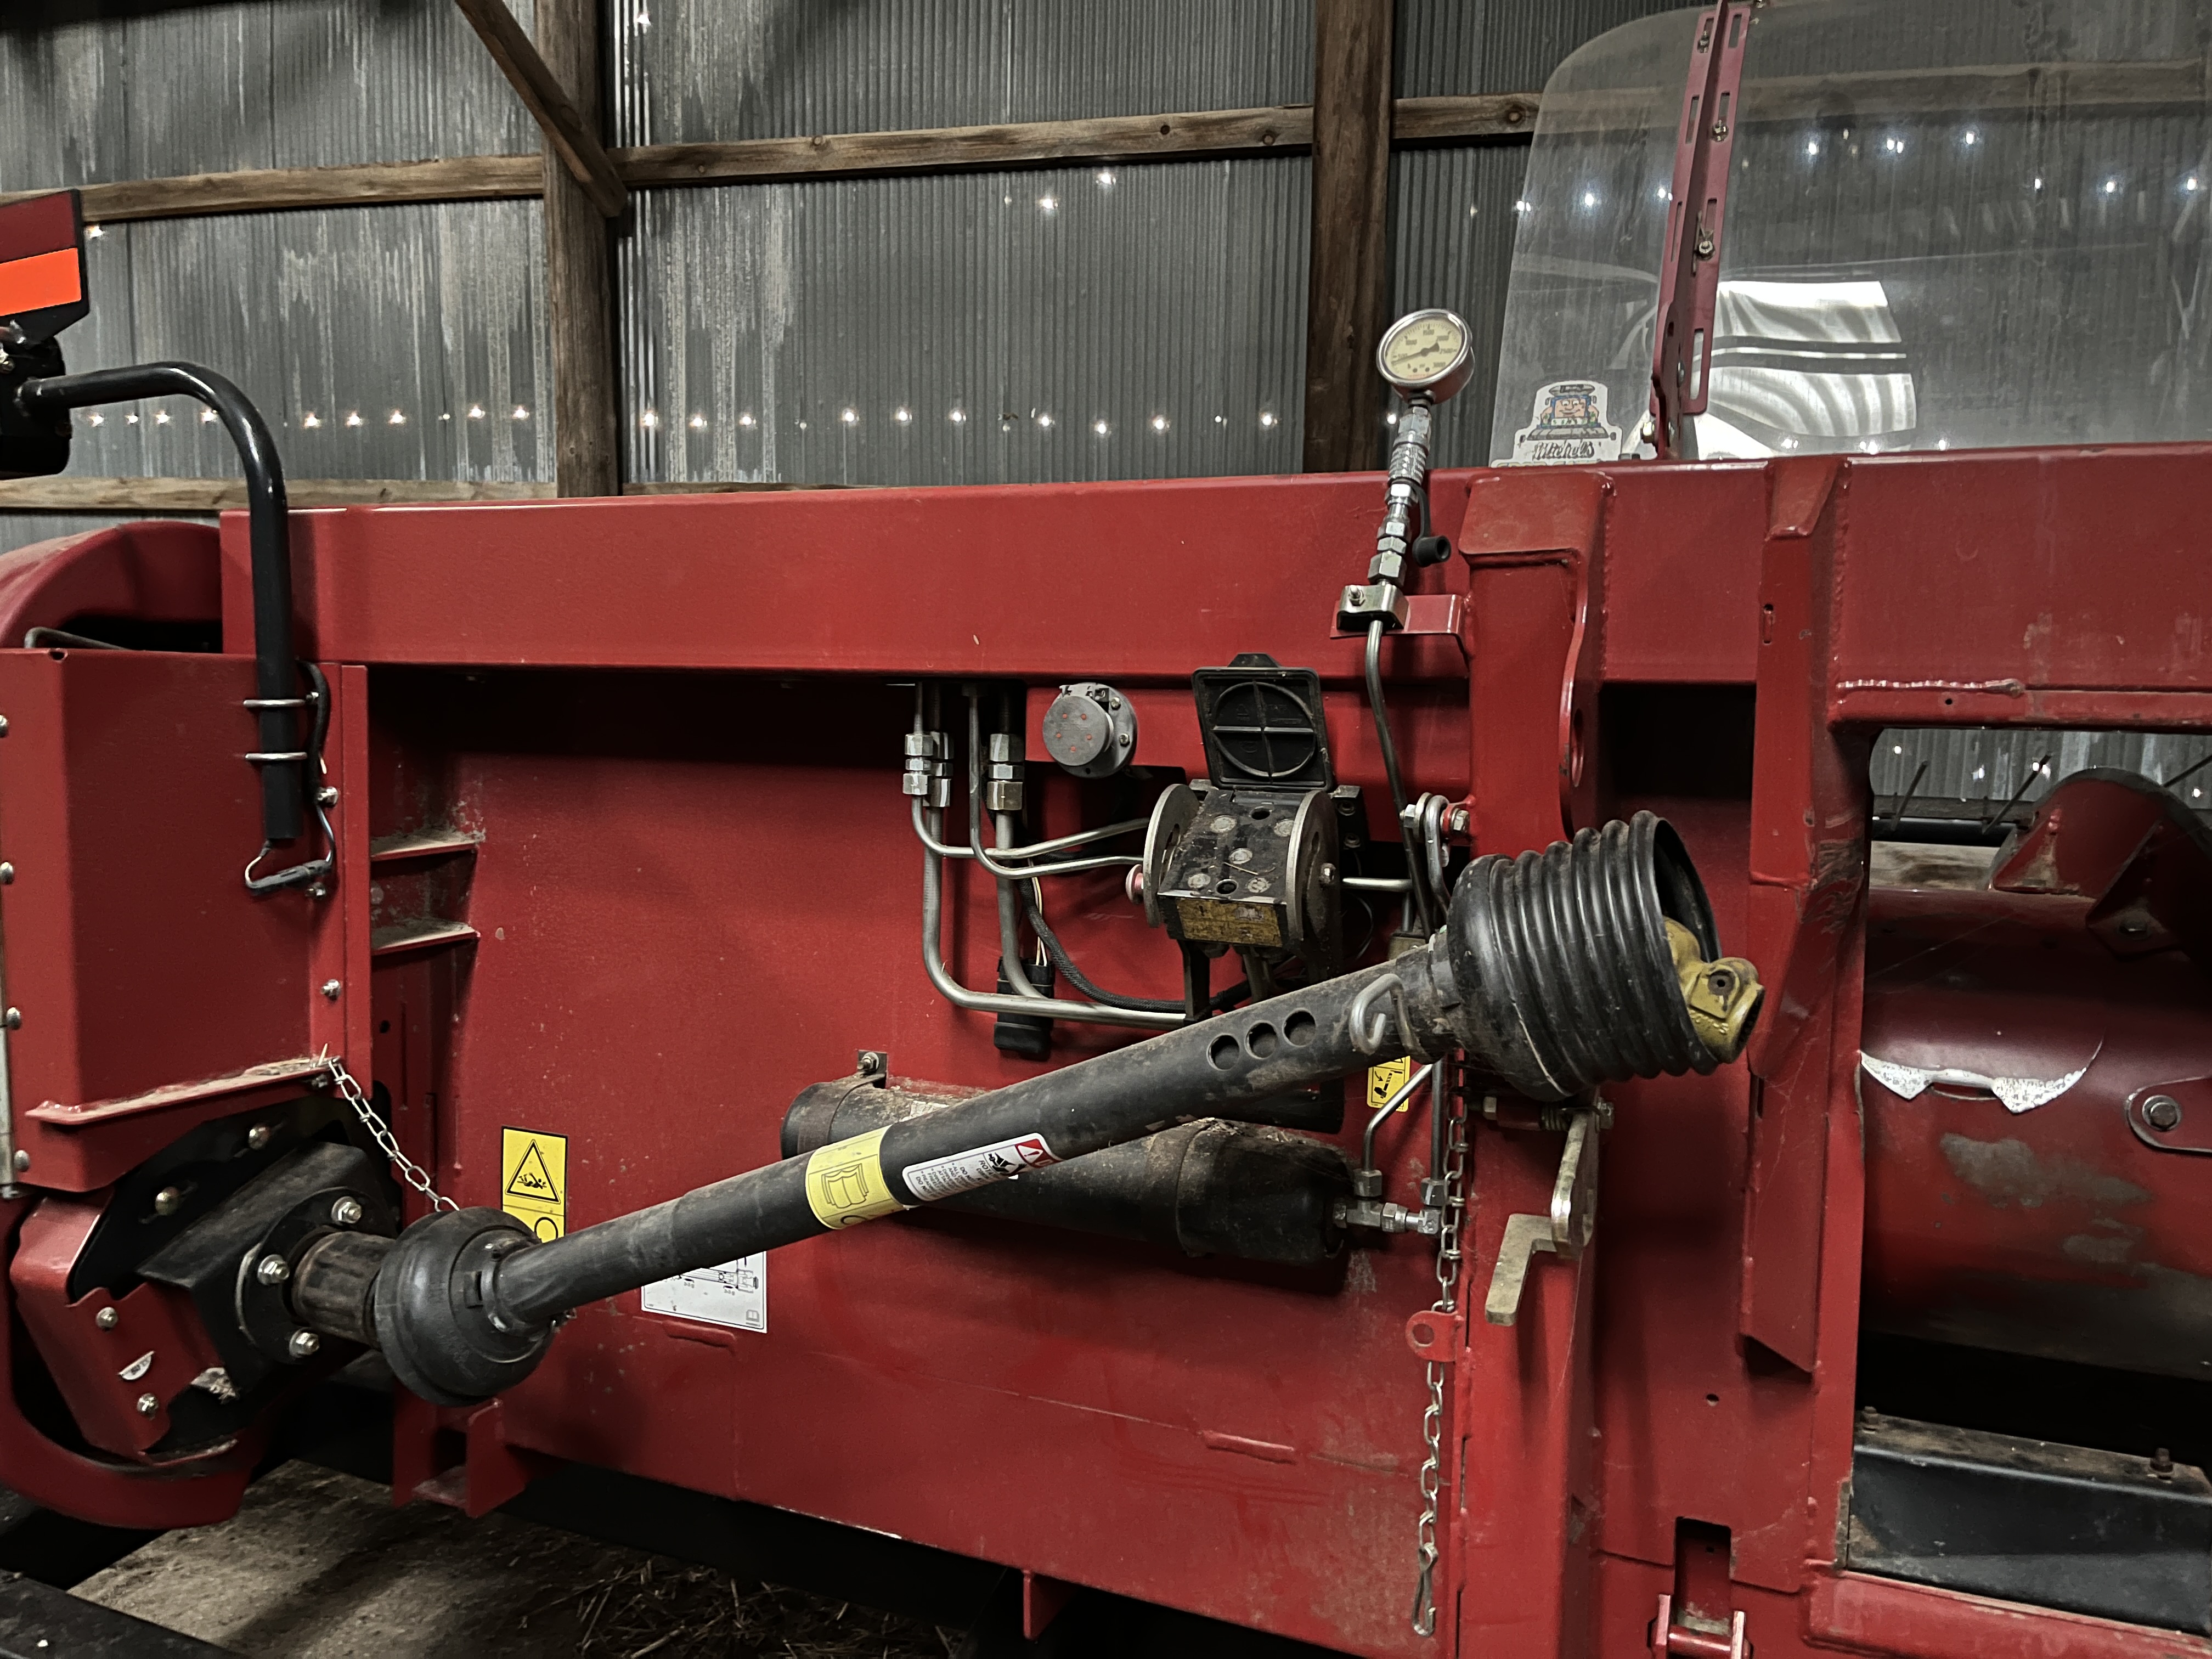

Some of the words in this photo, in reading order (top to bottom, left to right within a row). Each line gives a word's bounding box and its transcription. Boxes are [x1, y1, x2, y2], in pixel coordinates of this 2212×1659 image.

[947, 1167, 957, 1177] AND
[960, 1166, 968, 1175] DO
[915, 1176, 924, 1185] DO
[920, 1185, 932, 1194] NOT
